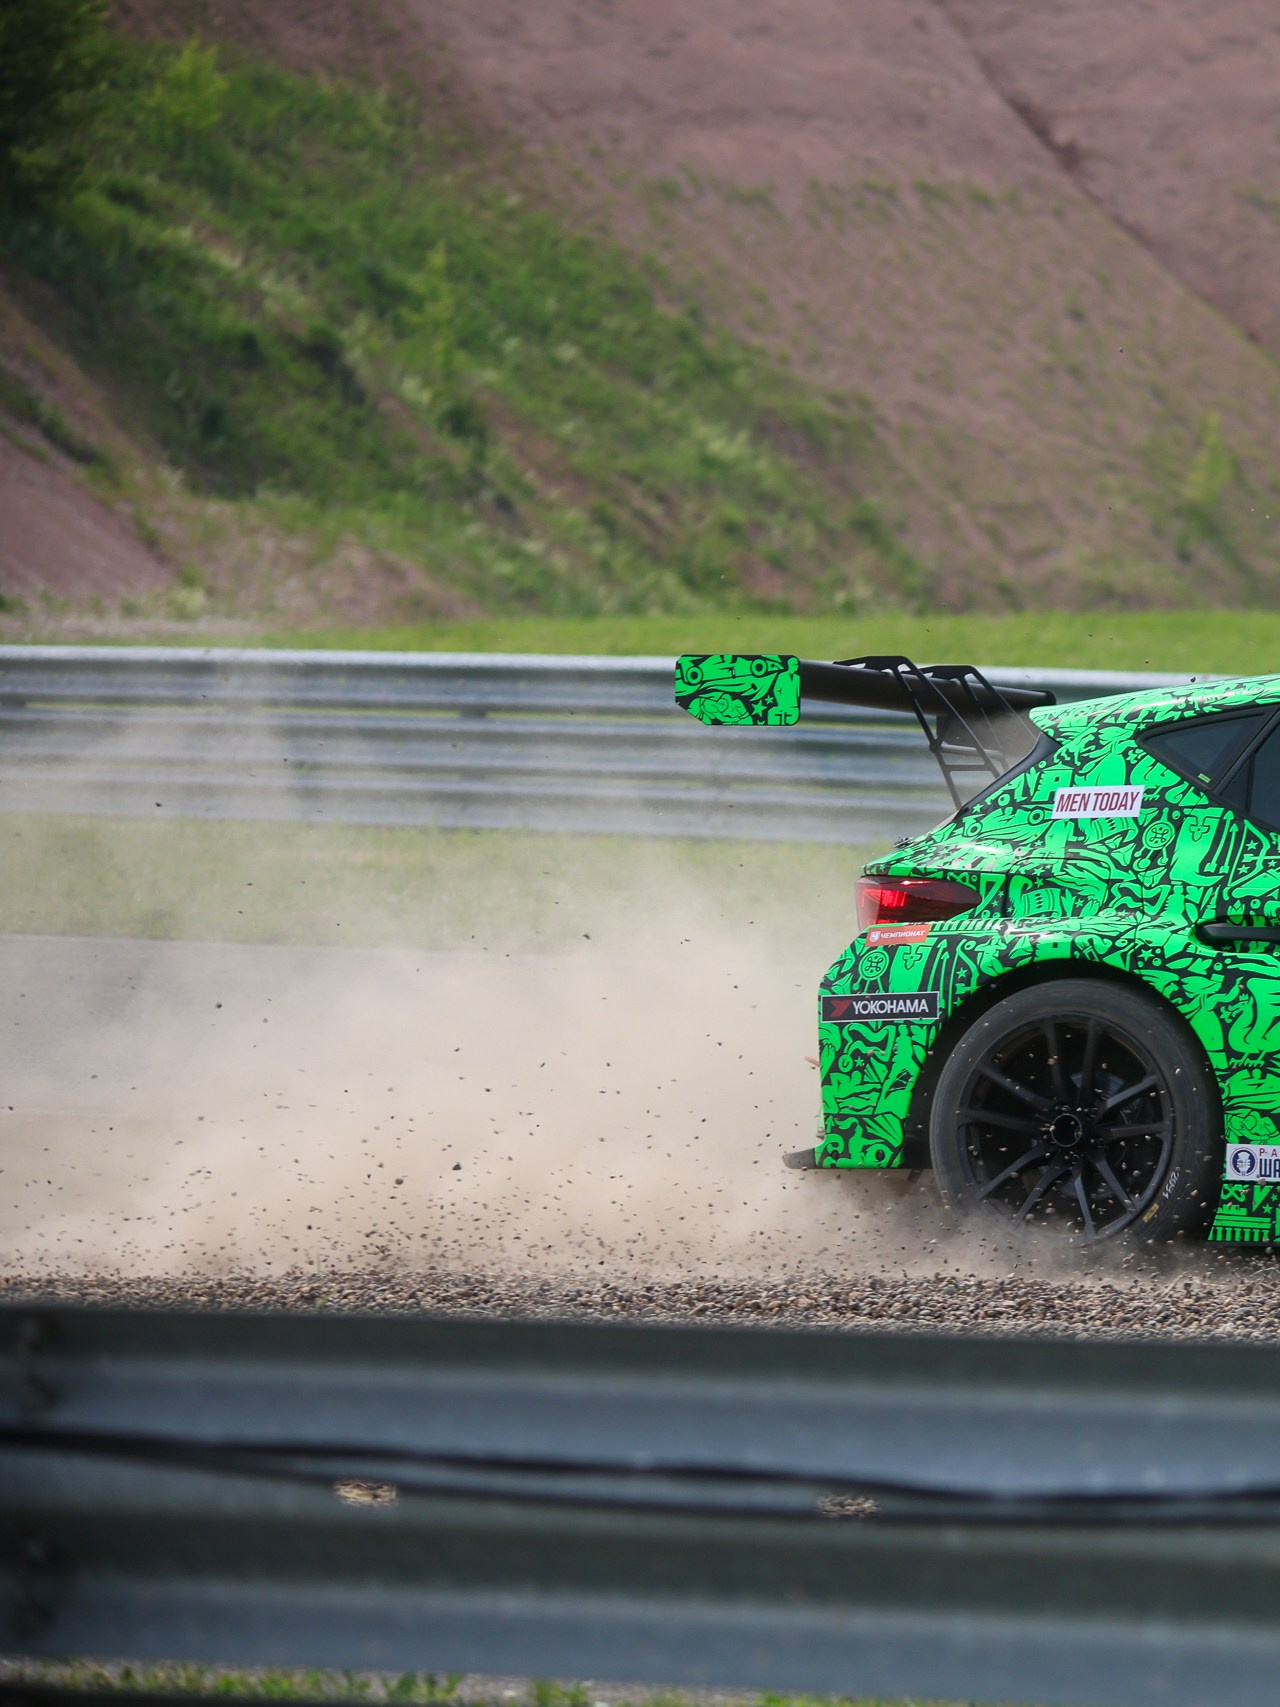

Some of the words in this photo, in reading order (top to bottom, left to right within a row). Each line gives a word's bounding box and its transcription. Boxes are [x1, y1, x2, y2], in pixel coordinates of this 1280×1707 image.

[1056, 793, 1091, 812] MEN
[1093, 791, 1140, 811] TODAY
[880, 930, 926, 939] ЧЕМПИОНАТ
[853, 999, 929, 1014] YOKOHAMA
